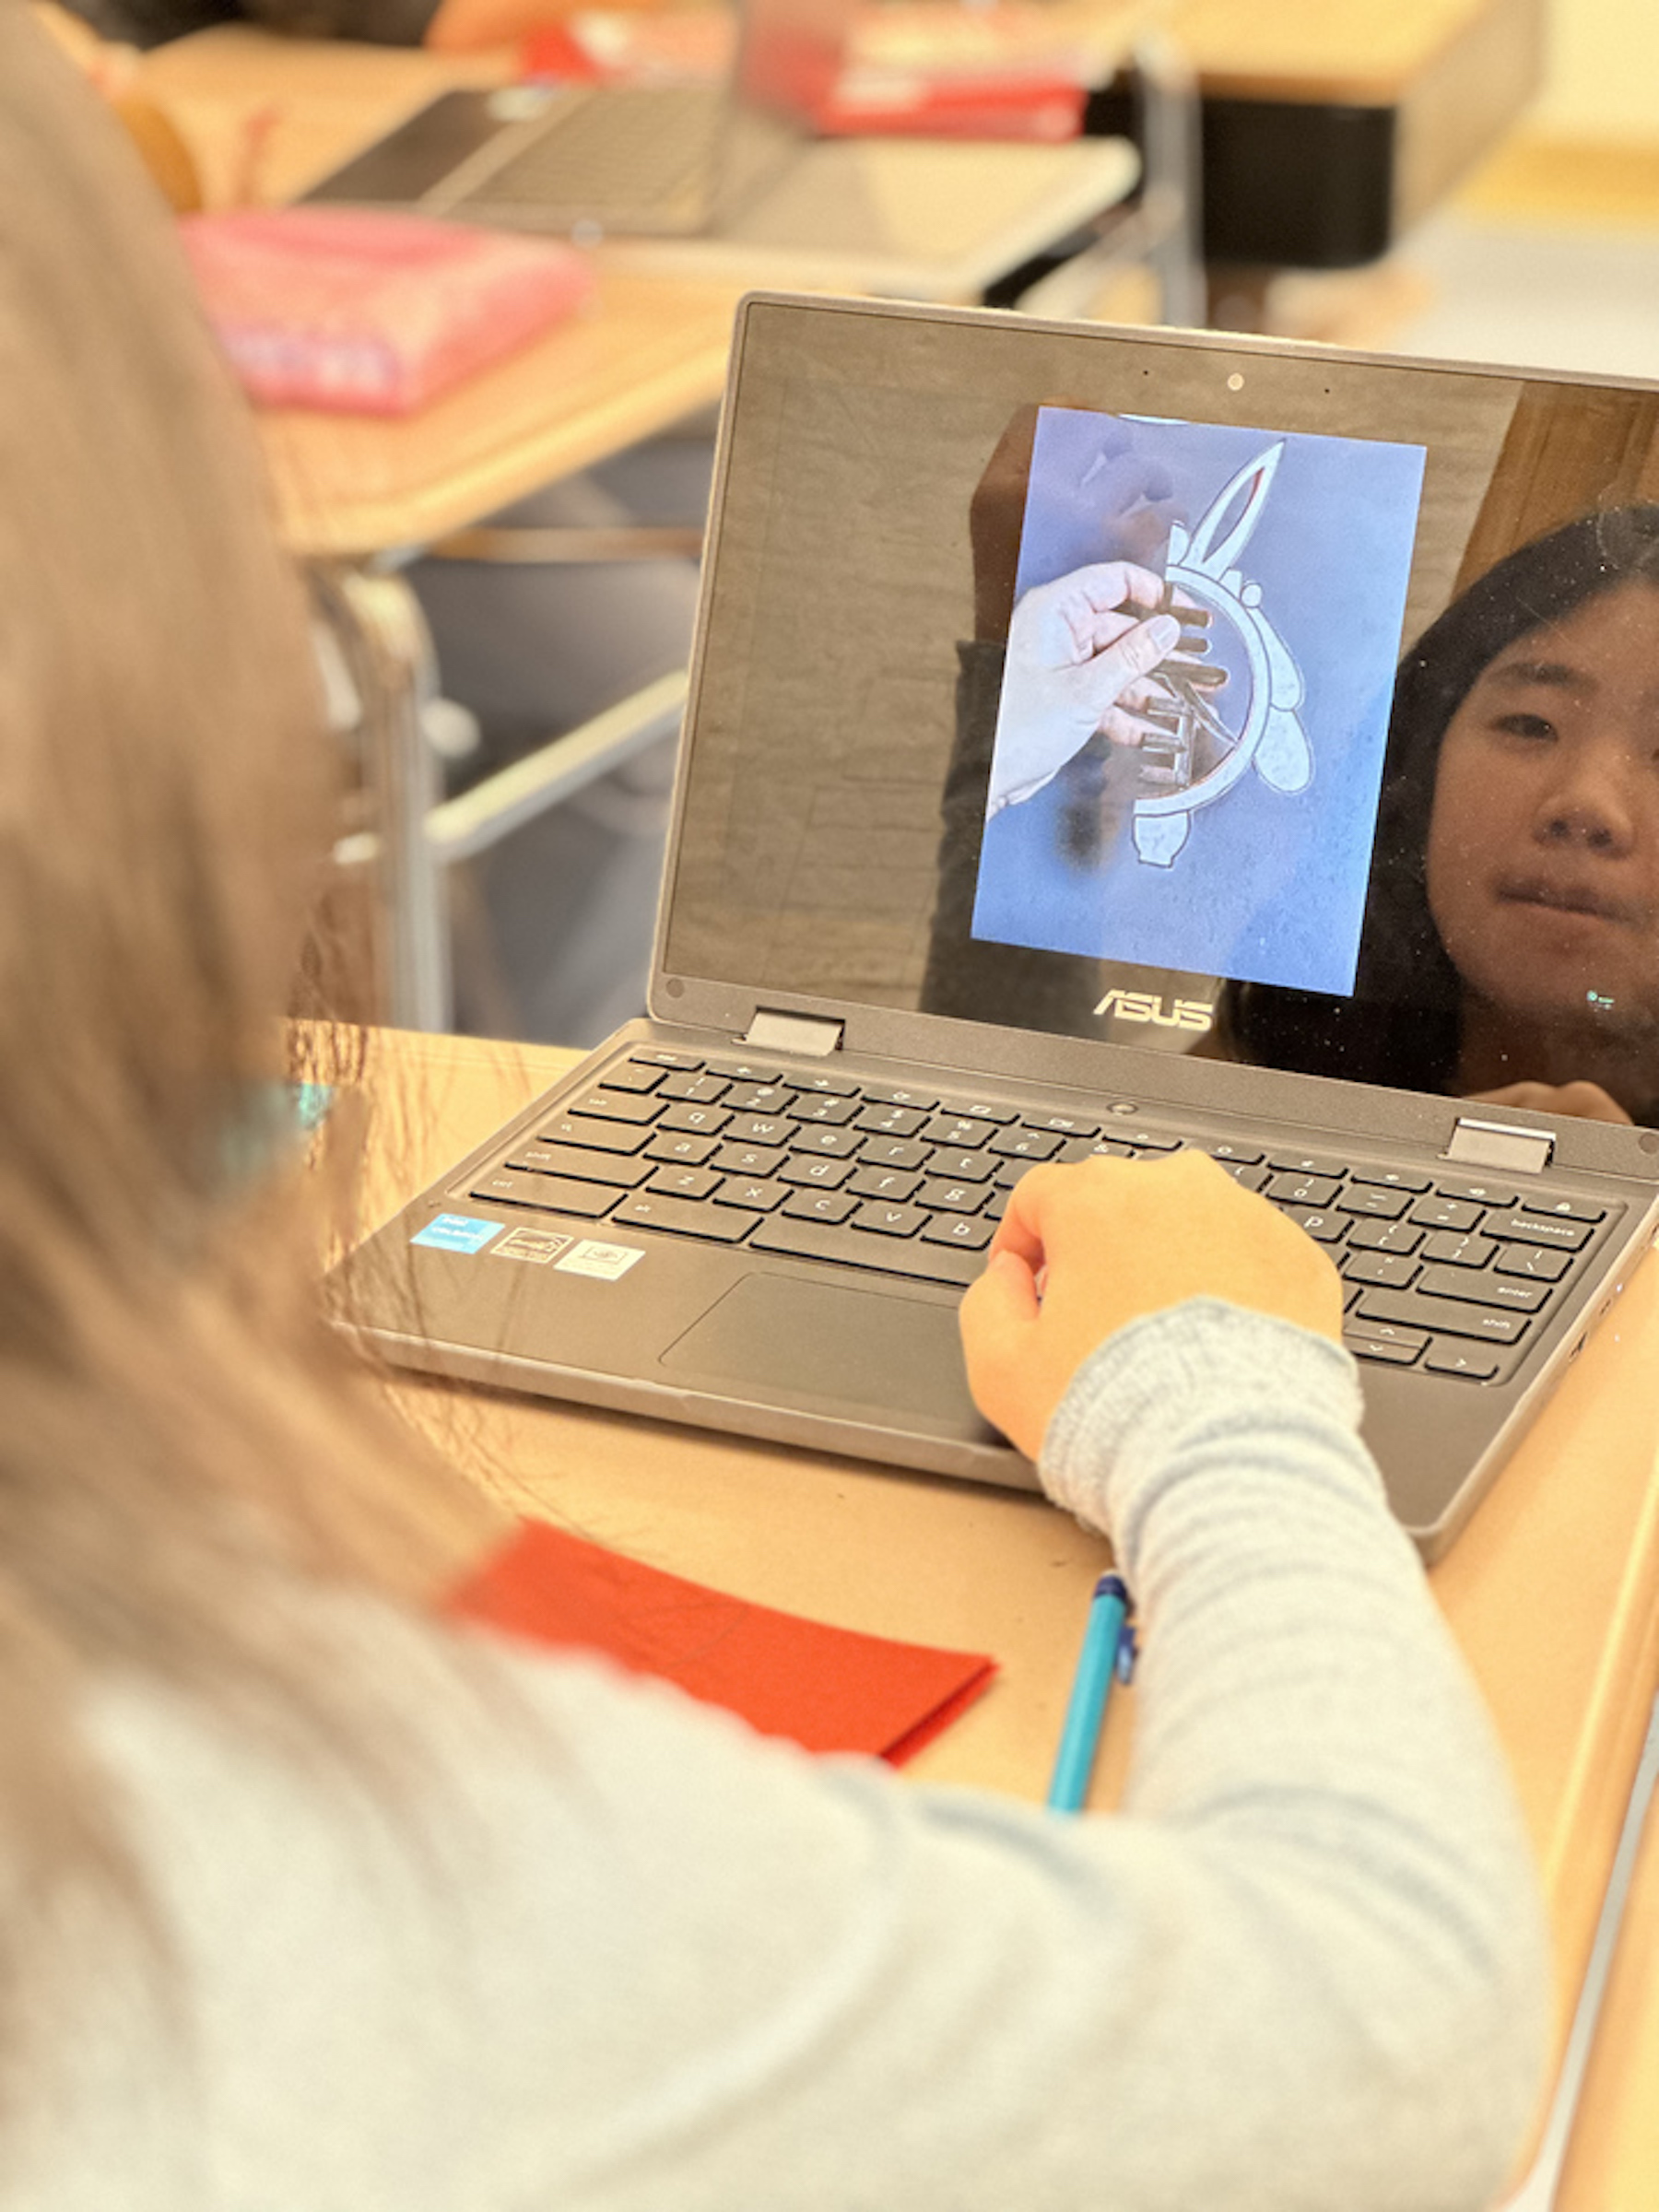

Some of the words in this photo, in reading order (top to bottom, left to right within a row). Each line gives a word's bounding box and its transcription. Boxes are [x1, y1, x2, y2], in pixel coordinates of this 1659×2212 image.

[1094, 990, 1213, 1031] ASUS
[688, 1112, 706, 1124] q
[752, 1123, 775, 1134] w
[674, 1142, 691, 1153] a
[741, 1153, 758, 1163] s
[809, 1165, 830, 1177] d
[878, 1176, 895, 1188] f
[745, 1187, 763, 1197] x
[815, 1199, 830, 1210] c
[886, 1212, 902, 1222] v
[1302, 1216, 1324, 1230] p
[952, 1222, 971, 1236] b
[1511, 1218, 1575, 1240] backspace
[1497, 1287, 1533, 1299] enter
[1482, 1319, 1511, 1329] shift
